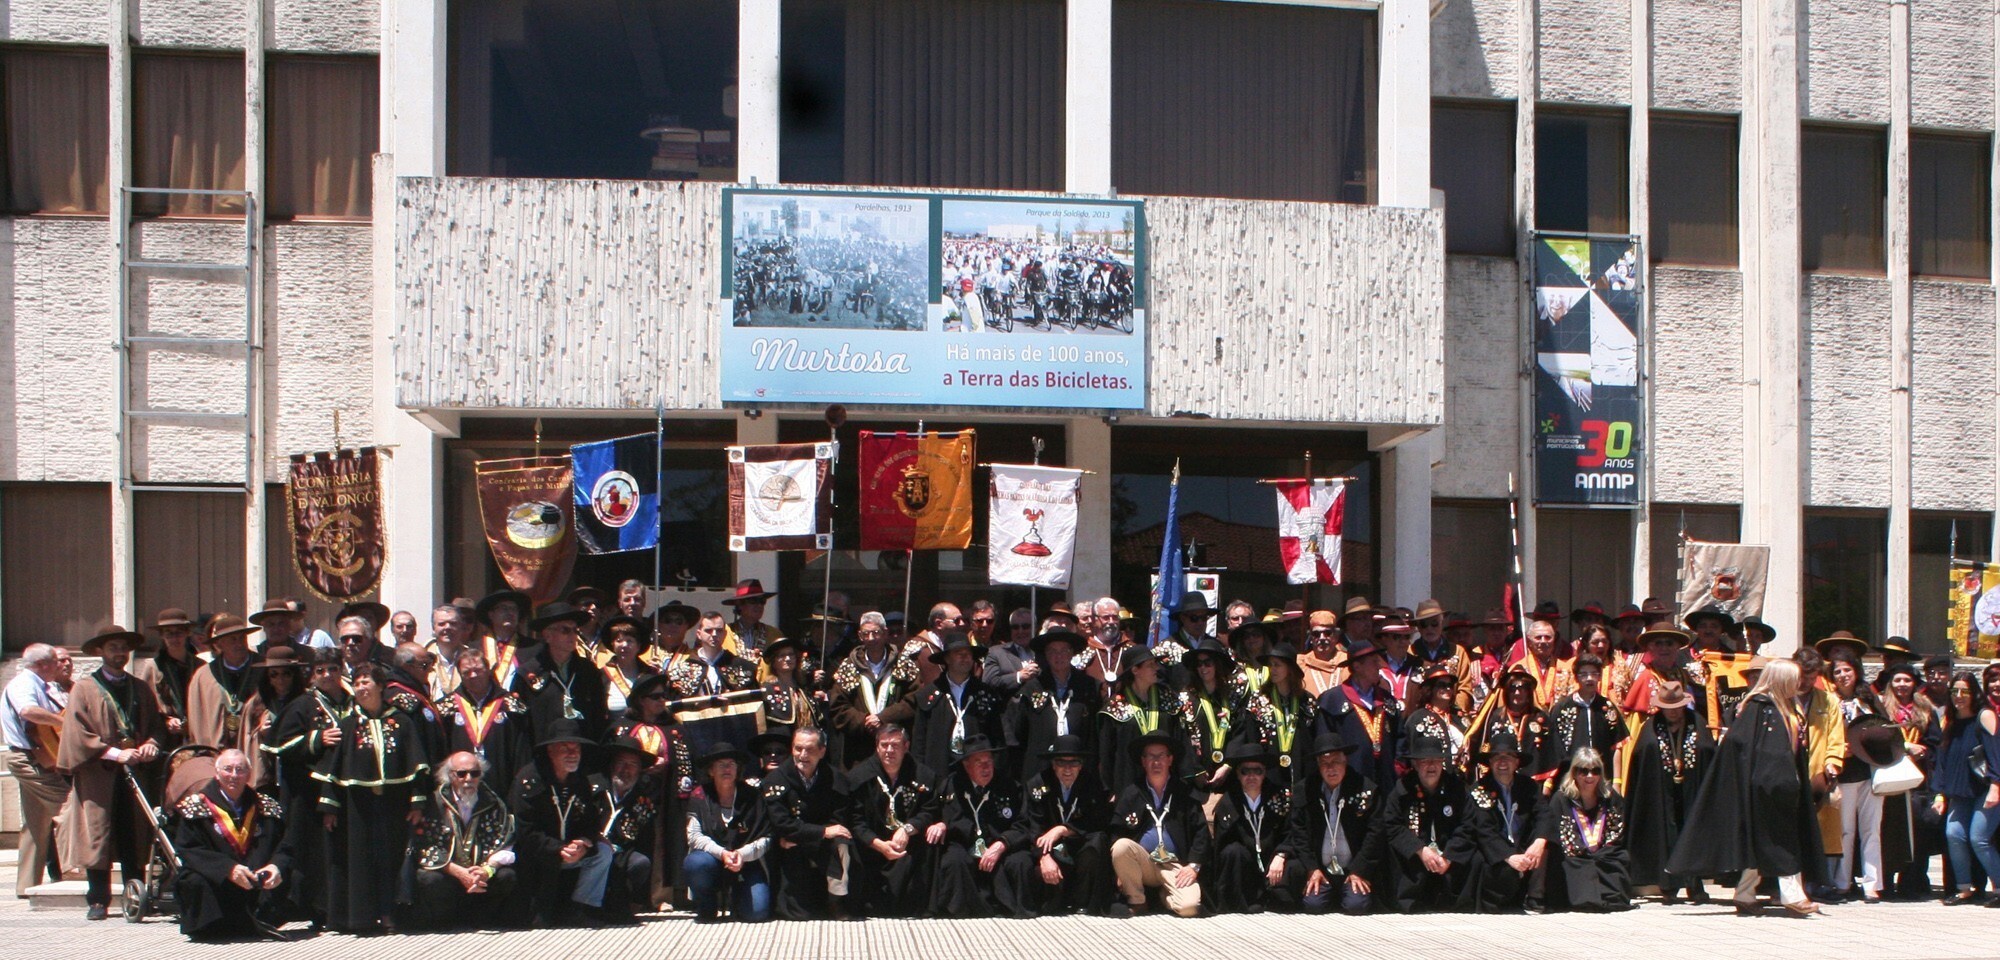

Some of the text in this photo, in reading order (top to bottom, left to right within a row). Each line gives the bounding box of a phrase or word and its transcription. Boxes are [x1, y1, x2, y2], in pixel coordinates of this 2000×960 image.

[894, 204, 912, 213] 1913
[1026, 208, 1051, 218] Parque
[1092, 210, 1111, 219] 2013
[751, 338, 912, 374] Murtosa
[946, 343, 1130, 367] Há mais de 100 anos,
[943, 370, 1133, 390] a Terra das Bicicletas.
[1576, 420, 1633, 468] 30
[296, 472, 373, 489] CONFRARIA
[309, 491, 374, 508] VALONGO
